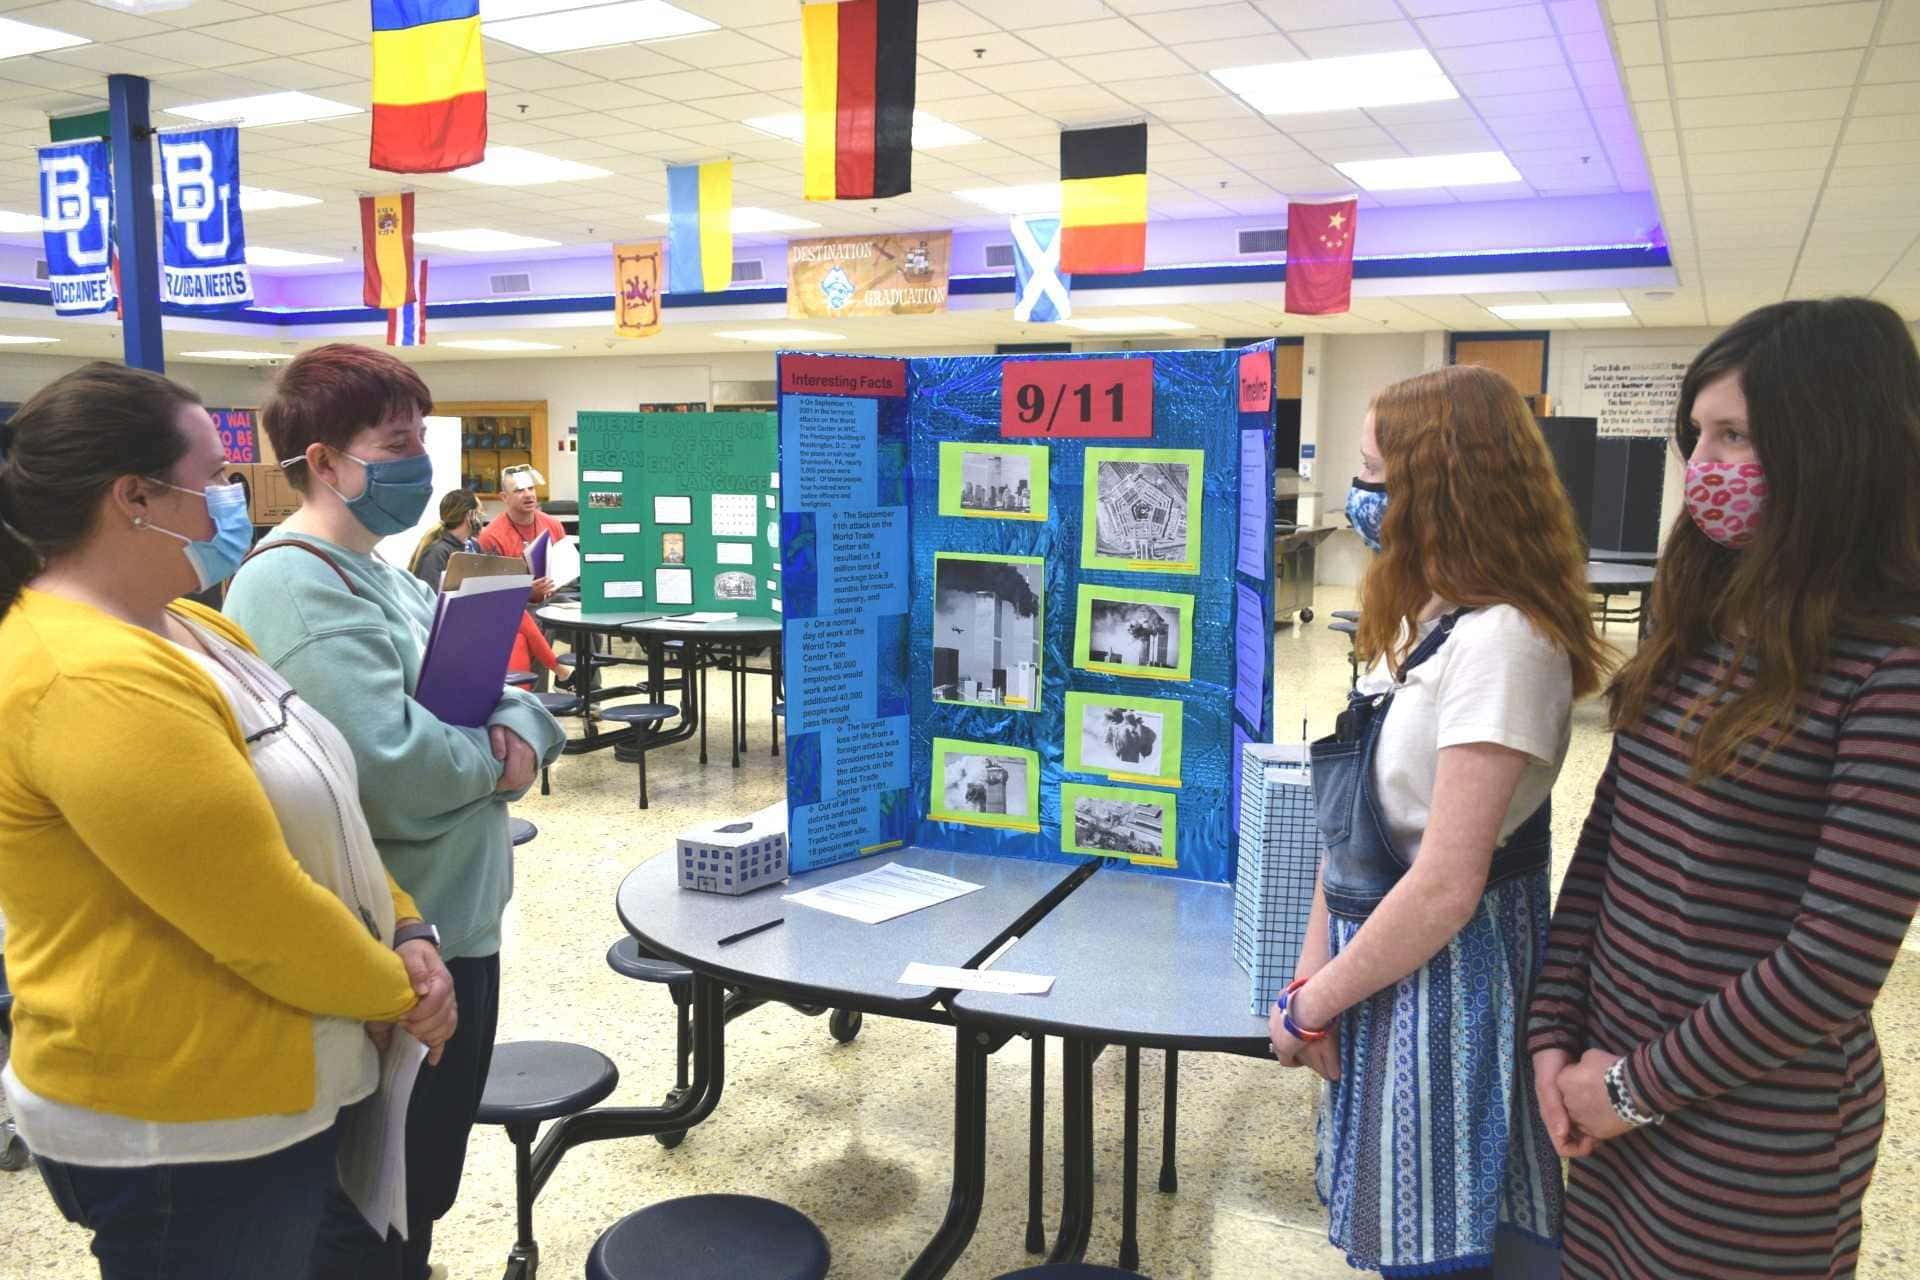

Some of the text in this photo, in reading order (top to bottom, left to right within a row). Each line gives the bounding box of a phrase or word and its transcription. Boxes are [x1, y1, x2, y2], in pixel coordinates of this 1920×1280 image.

[792, 242, 873, 262] DESTINATION
[864, 287, 945, 306] GRADUATION
[791, 373, 893, 391] Interesting Facts
[1242, 376, 1268, 401] Timeline
[1017, 383, 1124, 432] 9/11
[579, 416, 645, 432] WHERE
[602, 432, 624, 450] IT
[675, 475, 770, 491] LANGUAGE
[882, 520, 892, 528] the
[833, 532, 853, 540] World
[833, 543, 856, 551] Center
[815, 620, 825, 628] On
[832, 617, 857, 626] normal
[803, 632, 815, 641] day
[817, 630, 824, 638] of
[826, 629, 844, 637] work
[803, 641, 846, 652] World Trade
[803, 652, 827, 662] Center
[803, 670, 863, 684] employees would
[803, 686, 821, 695] work
[823, 685, 836, 693] and
[803, 704, 849, 718] people would
[803, 719, 820, 729] pass
[847, 720, 885, 731] The largest
[837, 735, 850, 743] loss
[852, 733, 859, 742] of
[860, 732, 871, 741] life
[873, 730, 888, 739] from
[837, 745, 860, 755] foreign
[862, 742, 884, 751] attack
[837, 754, 875, 766] considered
[837, 767, 848, 776] the
[850, 765, 871, 774] attack
[837, 774, 879, 786] World Trade
[837, 788, 860, 797] Center
[818, 803, 831, 812] Out
[832, 801, 839, 809] of
[808, 806, 867, 825] debris and rubble
[808, 818, 858, 834] from the World
[808, 837, 828, 846] Trade
[830, 830, 853, 841] Center
[819, 844, 841, 855] people
